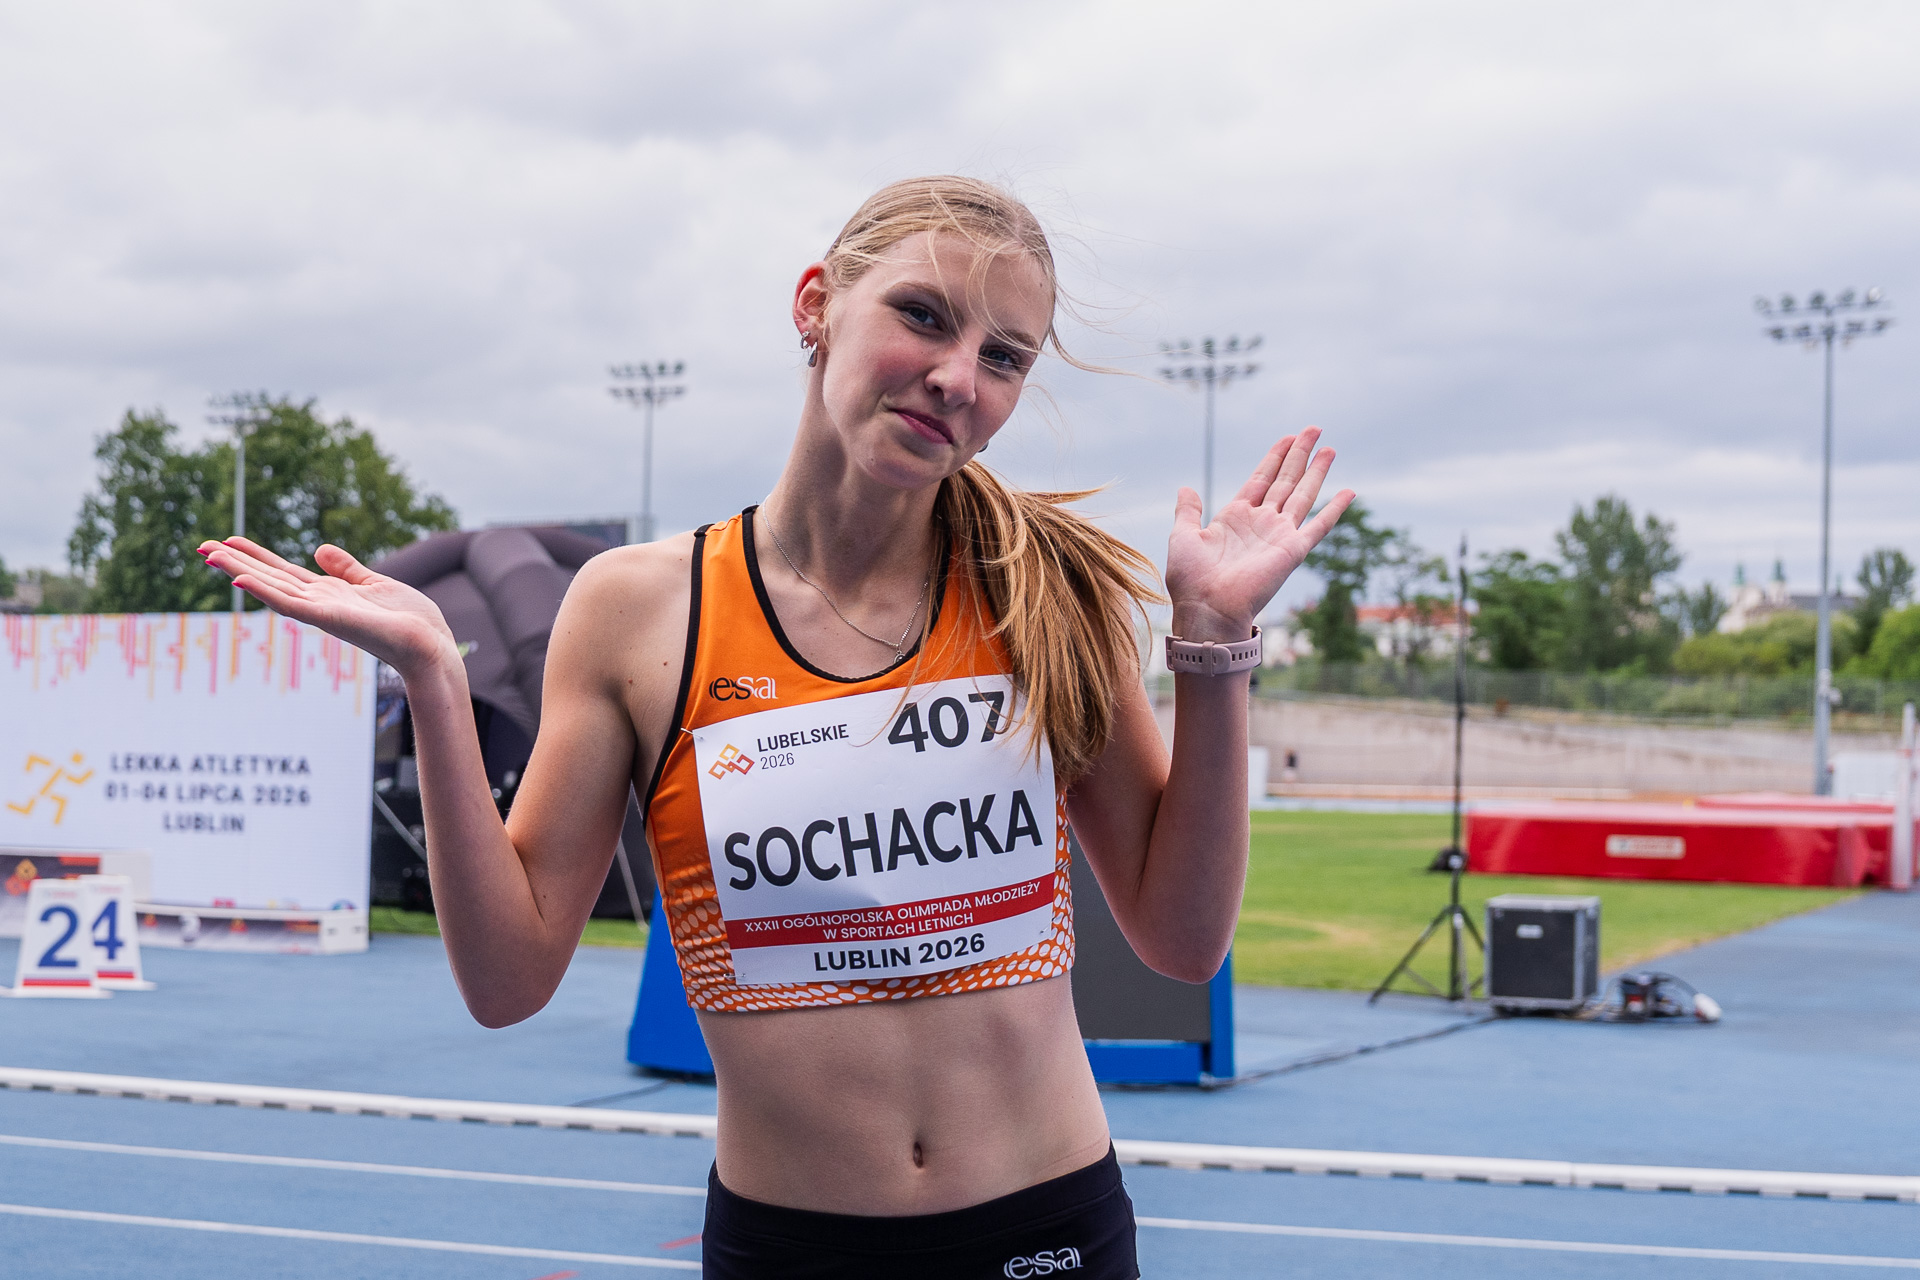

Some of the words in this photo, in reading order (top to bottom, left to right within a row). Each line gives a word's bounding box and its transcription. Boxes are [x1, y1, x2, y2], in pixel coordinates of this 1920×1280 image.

[709, 676, 778, 701] esa
[887, 690, 1005, 753] 407
[757, 723, 849, 752] LUBELSKIE
[110, 754, 181, 774] LEKKA
[190, 754, 311, 775] ATLETYKA
[760, 752, 795, 770] 2026
[105, 781, 168, 802] 01-04
[176, 783, 244, 803] LIPCA
[254, 784, 311, 805] 2026
[163, 812, 245, 833] LUBLIN
[724, 789, 1043, 890] SOCHACKA
[744, 921, 780, 933] XXXII
[782, 910, 895, 930] OGÓLNOPOLSKA
[898, 899, 972, 920] OLIMPIADA
[974, 881, 1041, 907] MŁODZIEŻY
[37, 904, 79, 968] 2
[92, 900, 125, 961] 4
[822, 928, 838, 940] W
[840, 921, 916, 940] SPORTACH
[918, 912, 974, 933] LETNICH
[814, 946, 912, 971] LUBLIN
[918, 932, 986, 964] 2026
[1003, 1247, 1084, 1280] esa
